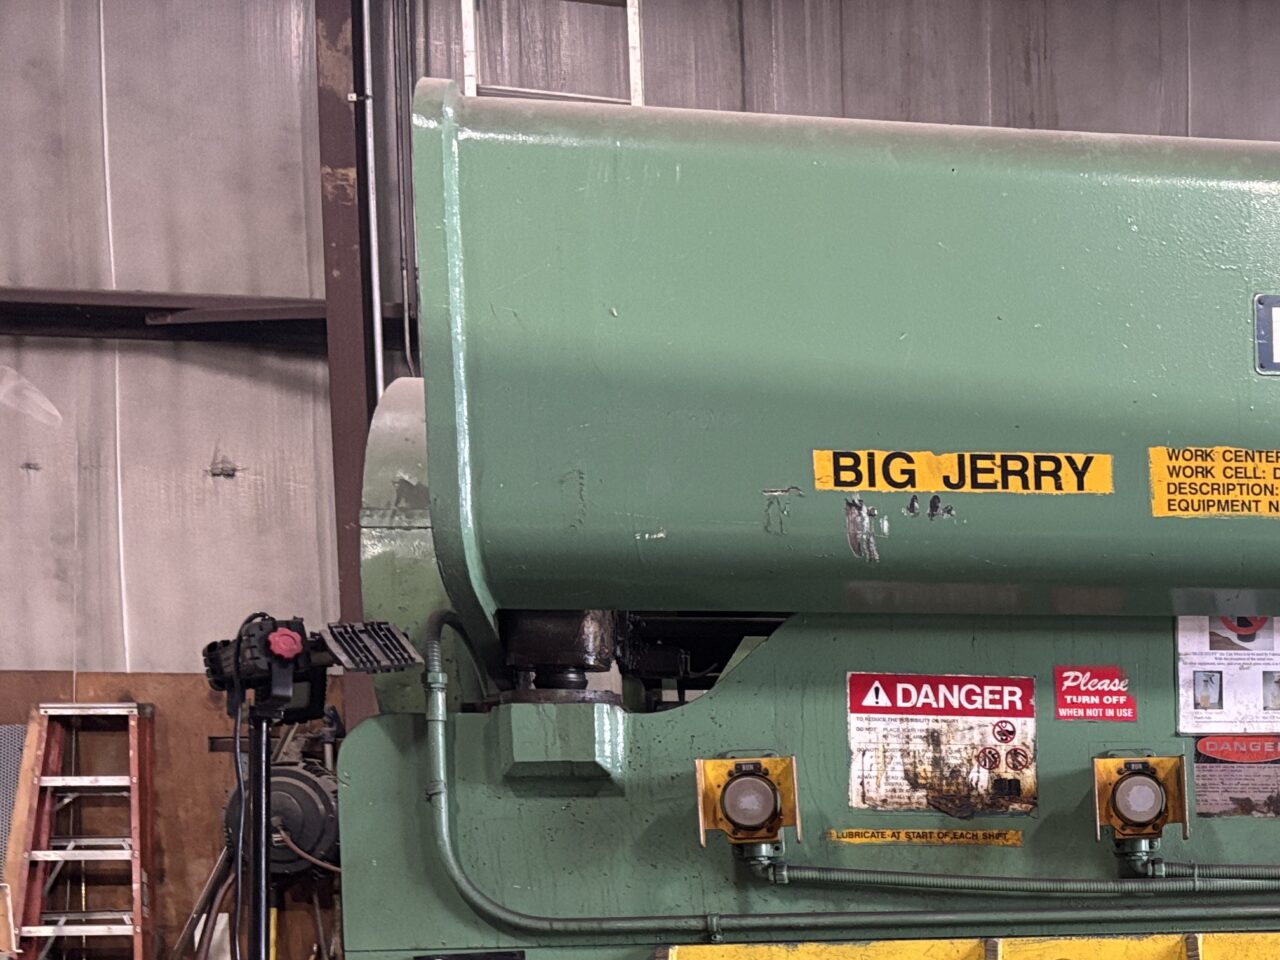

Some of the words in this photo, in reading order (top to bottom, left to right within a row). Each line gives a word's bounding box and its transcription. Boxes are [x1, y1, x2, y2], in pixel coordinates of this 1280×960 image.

[1166, 449, 1216, 462] WORK
[832, 451, 917, 489] BIG
[942, 453, 1095, 491] JERRY
[1167, 465, 1216, 479] WORK
[1222, 466, 1266, 480] CELL:
[1167, 482, 1279, 497] DESCRIPTION:
[1167, 499, 1261, 513] EQUIPMENT
[1061, 670, 1129, 692] Please
[895, 682, 1023, 711] DANGER
[1064, 695, 1100, 704] TURN
[1102, 695, 1127, 704] OFF
[1058, 708, 1084, 717] WHEN
[1086, 708, 1103, 717] NOT
[1105, 708, 1115, 717] IN
[1116, 708, 1134, 717] USE
[836, 831, 887, 839] LUBRICATE
[890, 831, 901, 840] AT
[904, 832, 933, 840] START
[953, 832, 978, 840] EACH
[981, 833, 1009, 841] SHIFT
